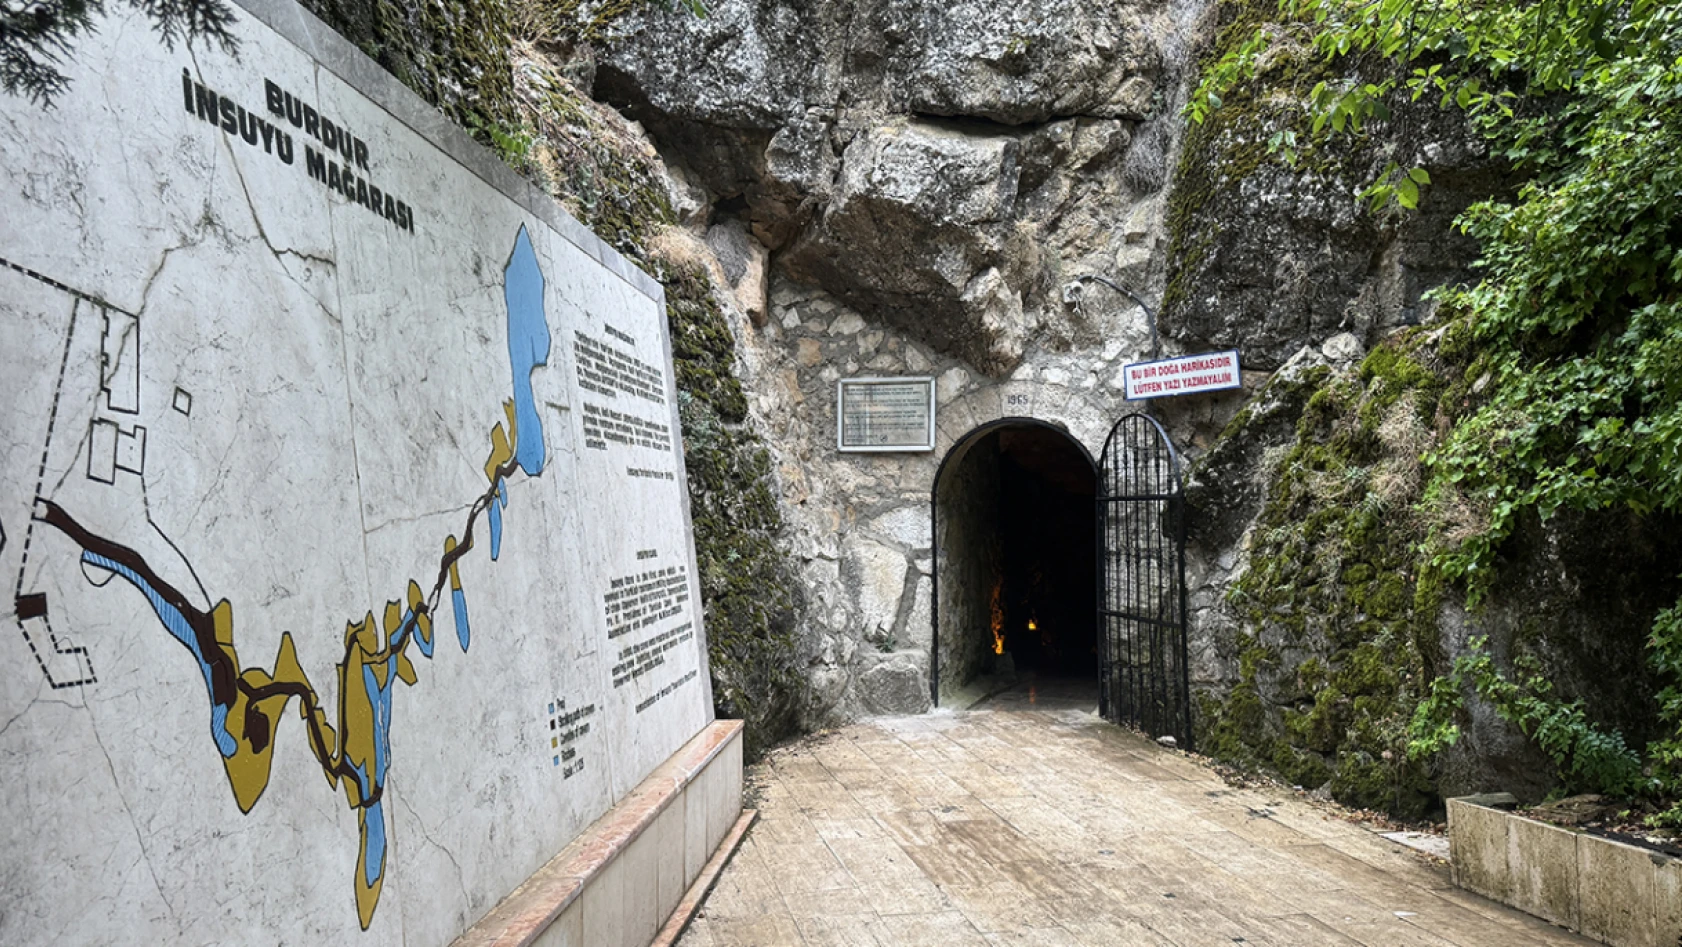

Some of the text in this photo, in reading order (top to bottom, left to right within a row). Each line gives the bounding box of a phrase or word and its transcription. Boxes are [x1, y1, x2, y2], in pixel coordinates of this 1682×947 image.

[264, 77, 371, 172] BURDUR
[181, 66, 415, 235] İNSUYU MAĞARASI
[1131, 357, 1231, 379] BU BİR DOĞA HARİKASIDIR
[1134, 373, 1231, 394] LÜTFEN YAZI YAZMAYALIM
[1007, 395, 1028, 404] 1965
